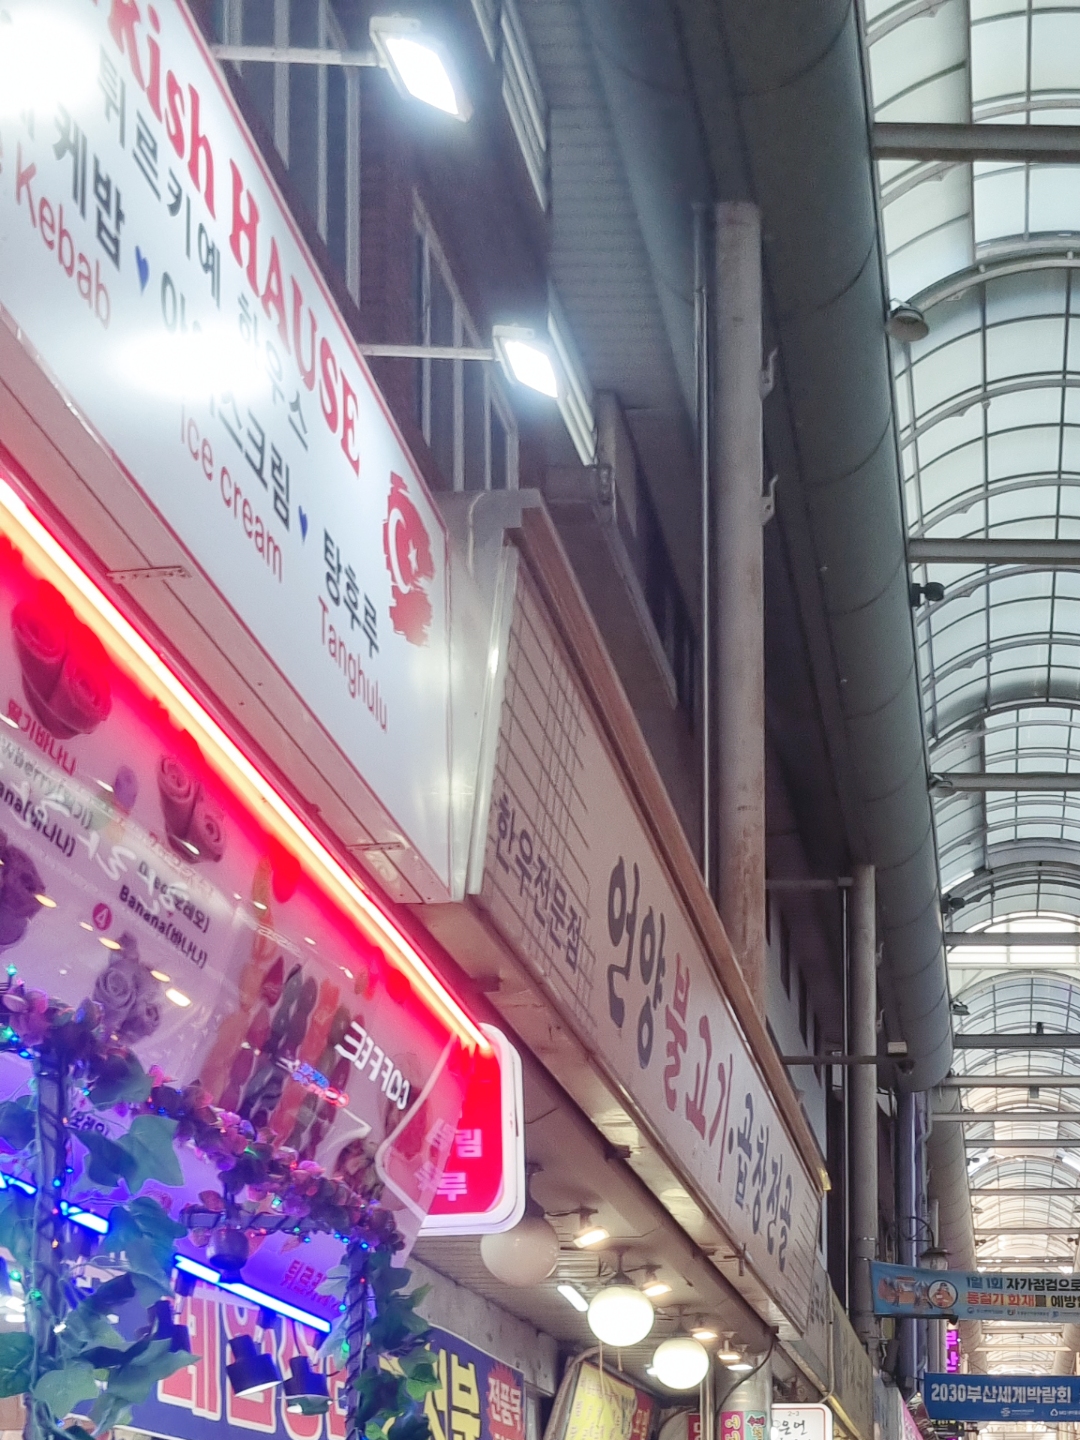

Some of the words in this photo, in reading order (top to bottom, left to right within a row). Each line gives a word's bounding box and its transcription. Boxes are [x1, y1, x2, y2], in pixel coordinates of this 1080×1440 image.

[16, 141, 110, 330] Kebab
[93, 0, 216, 220] kish
[229, 158, 360, 478] HAUSE
[179, 397, 213, 481] Ice
[221, 466, 283, 583] cream
[324, 527, 379, 658] 탕후루
[318, 595, 387, 732] Tanghulu
[966, 1276, 983, 1292] 1일
[986, 1276, 1004, 1292] 1회
[966, 1292, 1005, 1307] 동절기
[488, 1376, 522, 1431] 전품목
[931, 1383, 1072, 1405] 2030부산세계박람회
